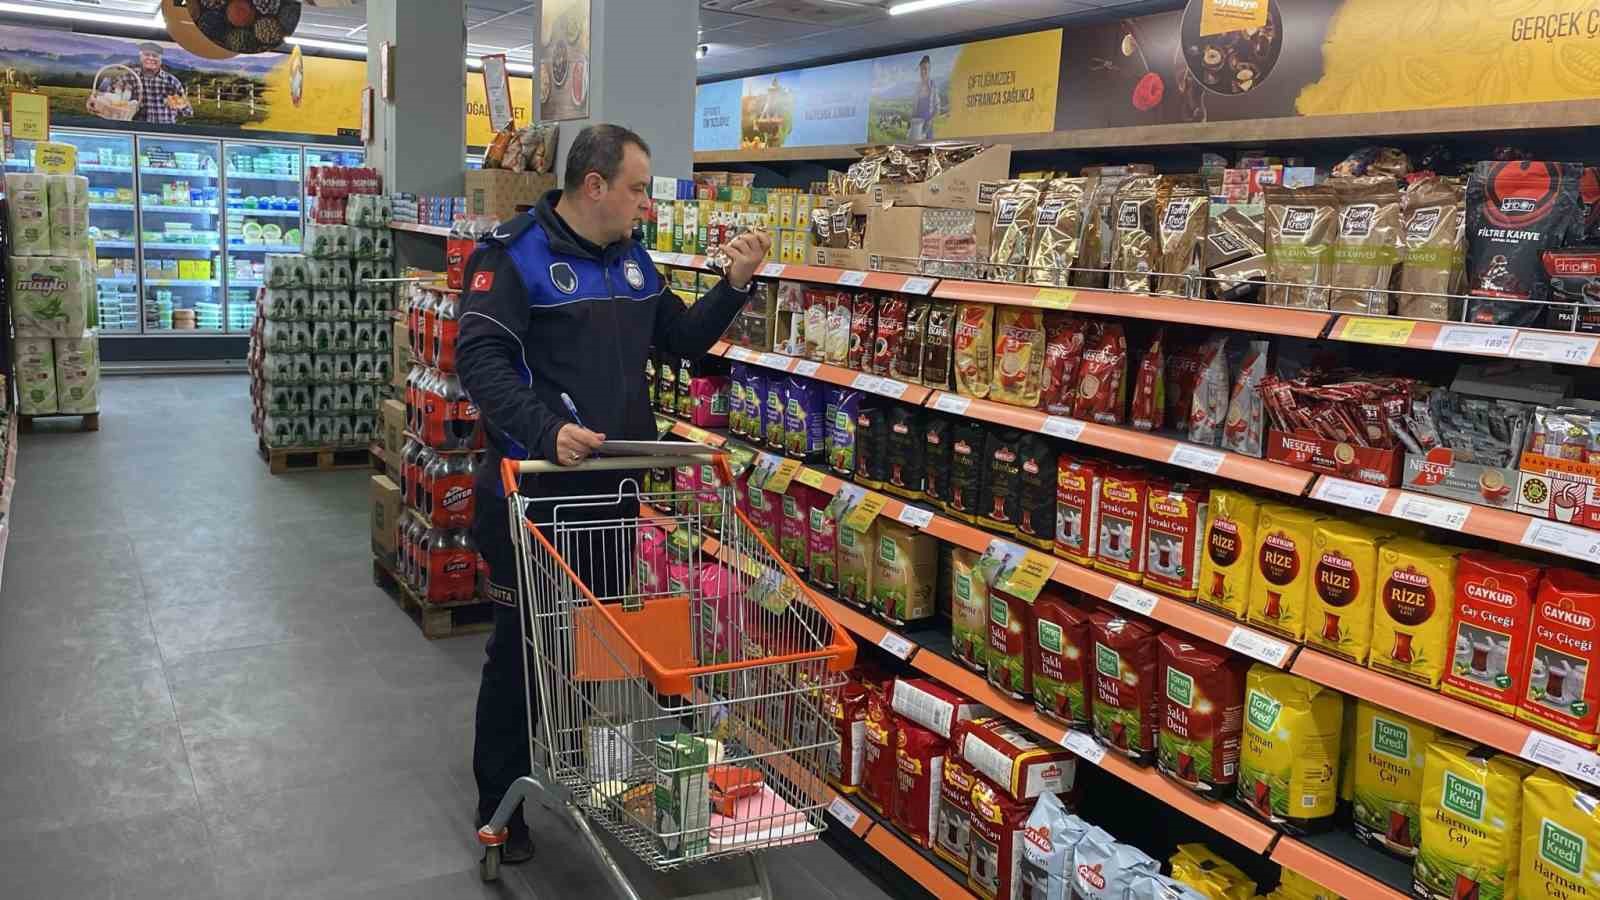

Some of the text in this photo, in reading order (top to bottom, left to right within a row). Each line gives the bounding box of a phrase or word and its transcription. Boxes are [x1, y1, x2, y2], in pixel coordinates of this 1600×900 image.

[1512, 11, 1582, 43] GERÇEK
[1478, 226, 1541, 241] FİLTRE KAHVE
[1212, 534, 1234, 551] RİZE
[1265, 551, 1292, 568] RİZE
[1321, 570, 1351, 589] RİZE
[1393, 570, 1428, 585] ÇAYKUR
[1391, 587, 1426, 607] RİZE
[1467, 585, 1514, 605] ÇAYKUR
[1460, 604, 1514, 628] Çay Çiçeği
[1544, 607, 1592, 627] ÇAYKUR
[1536, 625, 1593, 651] Çay Çiçeği
[1041, 652, 1062, 669] Saklı
[1042, 664, 1063, 680] Dem
[1098, 676, 1119, 696] Saklı
[1099, 690, 1119, 707] Dem
[1167, 704, 1188, 725] Saklı
[1167, 715, 1188, 737] Dem
[1377, 722, 1406, 740] Tarım
[1378, 734, 1404, 750] Kredi
[1368, 753, 1411, 777] Harman
[1379, 770, 1399, 785] Çay
[1449, 778, 1482, 799] Tarım
[1449, 792, 1478, 811] Kredi
[1436, 809, 1488, 839] Harman
[1448, 828, 1472, 848] Çay
[1546, 825, 1581, 852] Tarım
[1546, 840, 1577, 865] Kredi
[1534, 860, 1586, 895] Harman
